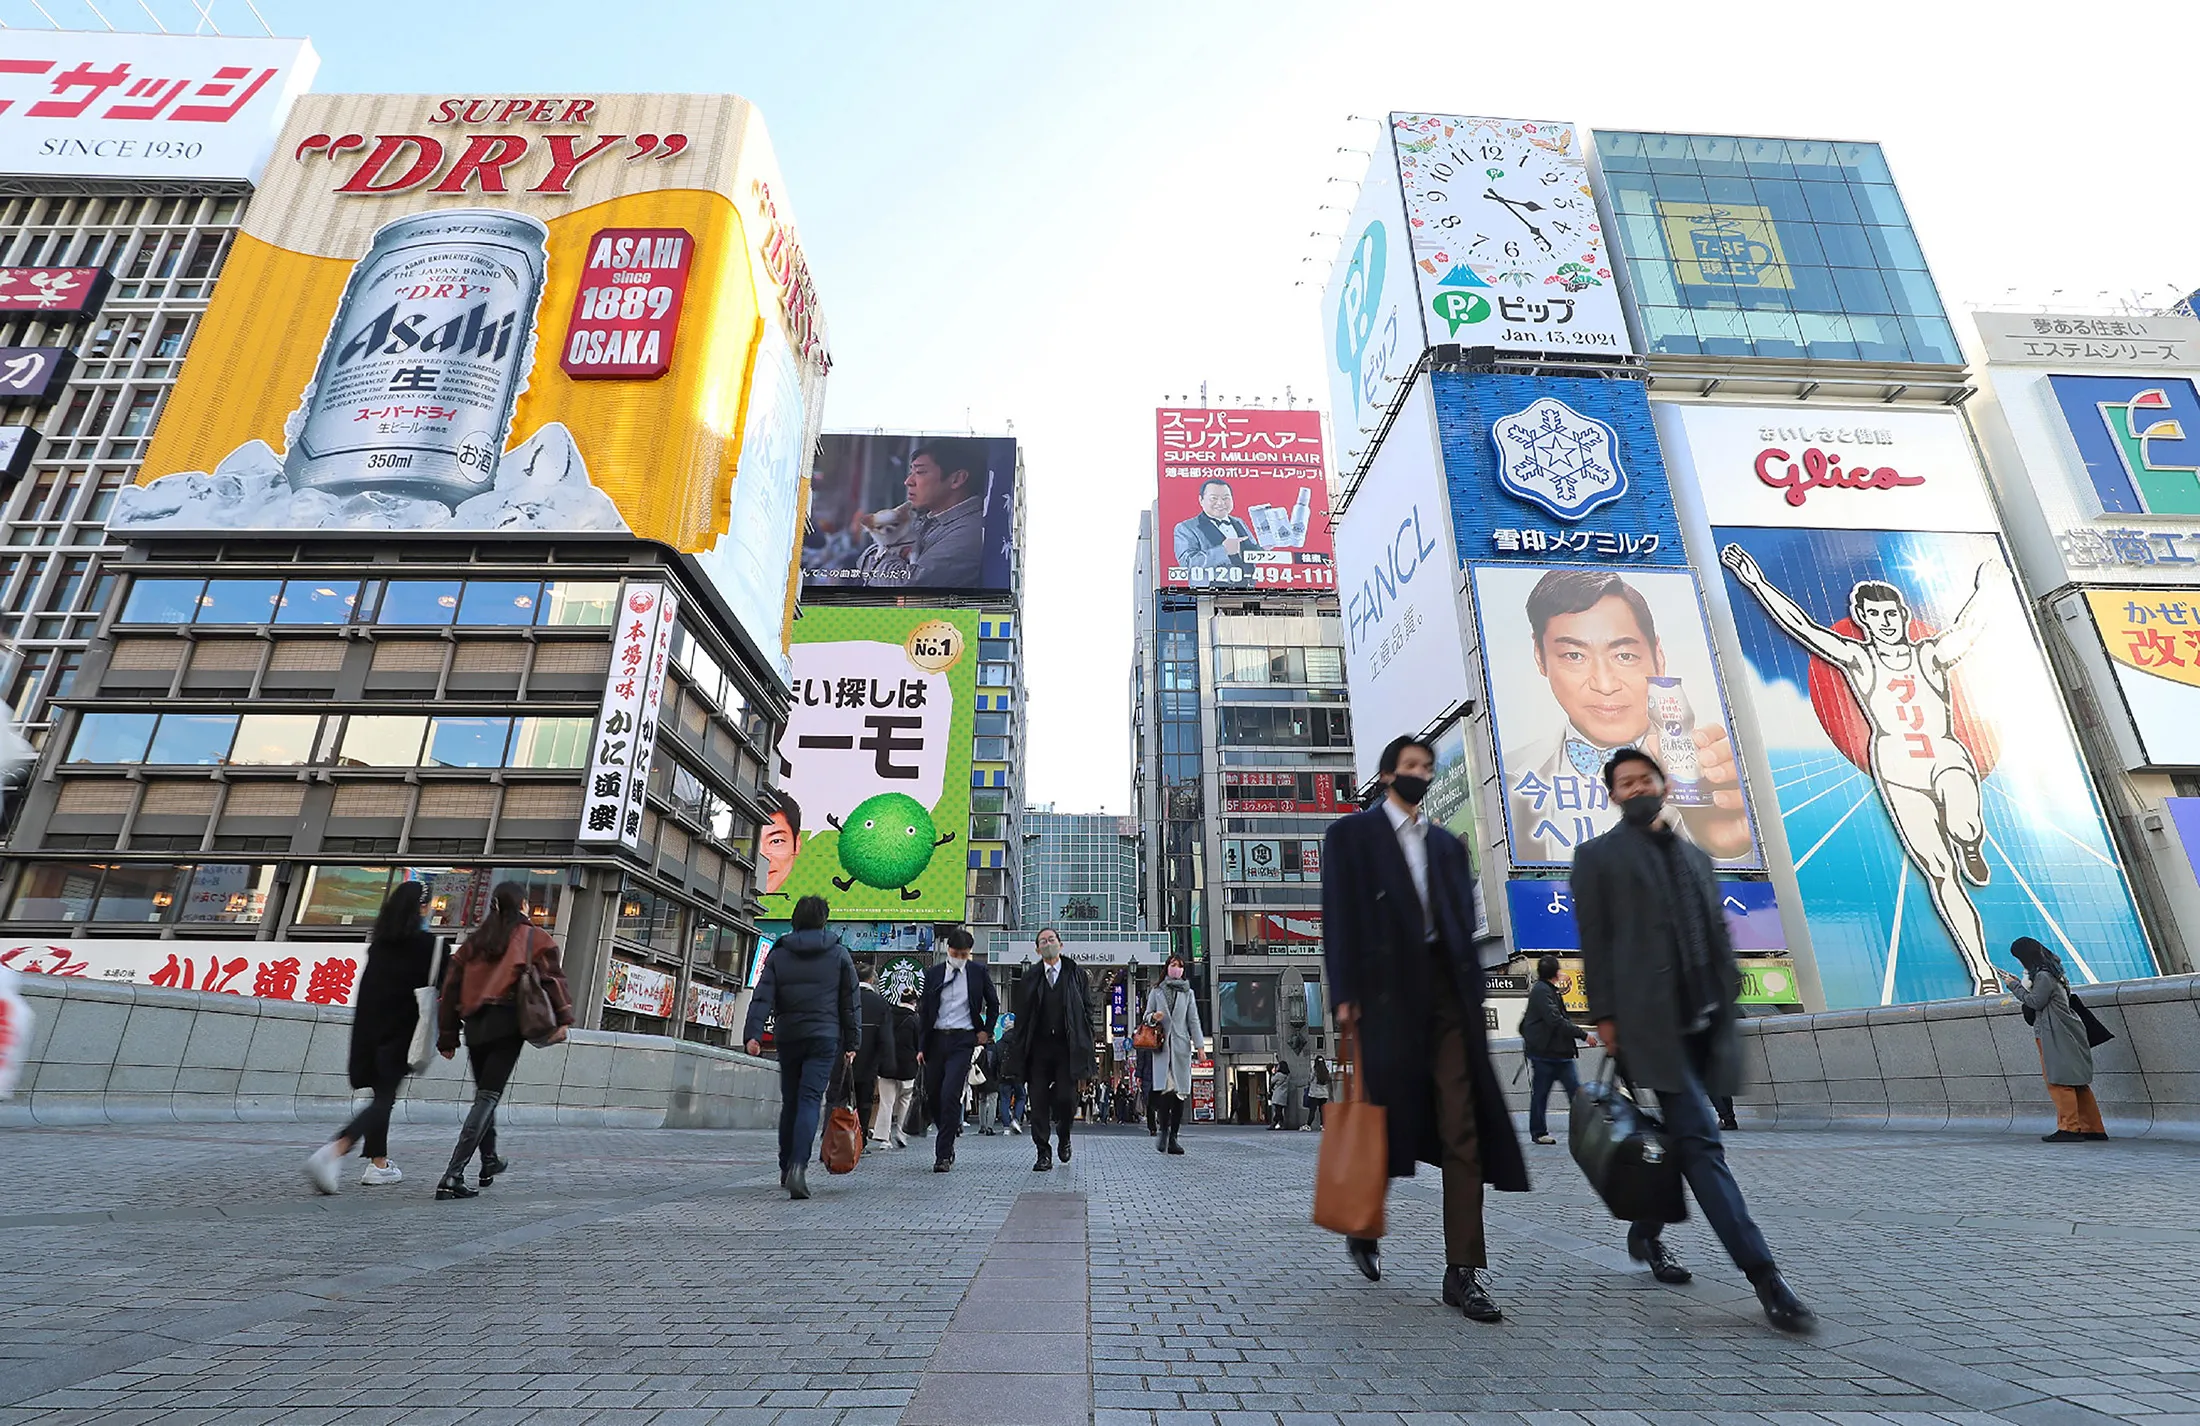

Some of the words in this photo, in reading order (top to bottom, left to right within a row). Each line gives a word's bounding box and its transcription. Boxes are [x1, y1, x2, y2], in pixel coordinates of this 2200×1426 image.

[0, 59, 279, 122] サッシ
[428, 98, 596, 125] SUPER
[39, 138, 142, 158] SINCE
[142, 141, 203, 161] 1930
[1450, 148, 1474, 166] 11
[1479, 146, 1504, 162] 12
[1519, 155, 1528, 167] 1
[1430, 162, 1454, 182] 10
[1539, 172, 1559, 187] 2
[1426, 190, 1448, 203] 9
[1553, 197, 1575, 209] 3
[1440, 215, 1461, 229] 8
[1551, 221, 1571, 234] 4
[1471, 233, 1490, 248] 7
[1504, 241, 1520, 258] 6
[1533, 235, 1552, 253] 5
[589, 237, 684, 269] ASAHI
[394, 272, 414, 280] THE
[418, 267, 458, 276] JAPAN
[463, 268, 501, 279] BRAND
[612, 270, 652, 285] since
[581, 286, 674, 320] 1889
[1497, 296, 1575, 324] ピップ
[337, 301, 517, 368] Asahi
[2032, 318, 2147, 336] 夢ある住まい
[570, 329, 661, 366] OSAKA
[2023, 342, 2180, 360] エステムシリーズ
[389, 366, 441, 391] 生
[353, 406, 458, 422] スーパードライ
[1163, 411, 1249, 430] スーパー
[376, 422, 422, 434] 生ビール
[1759, 426, 1894, 445] おいしさと健康
[1163, 430, 1319, 449] ミリオンヘアー
[367, 453, 414, 469] 350ml
[458, 442, 495, 475] お酒
[1164, 451, 1217, 462] SUPER
[1221, 451, 1278, 462] MILLION
[1282, 453, 1320, 463] HAIR
[1755, 448, 1926, 507] Glico
[1493, 528, 1660, 555] 雪印メグミルク
[1247, 553, 1276, 561] ルアン
[1191, 567, 1333, 584] 0120-494-111
[1348, 503, 1436, 655] FANCL
[915, 639, 951, 656] No.1
[616, 620, 647, 701] 本場の味
[1886, 674, 1935, 759] グリコ
[772, 715, 925, 780] ーモ
[1227, 801, 1239, 811] 5F
